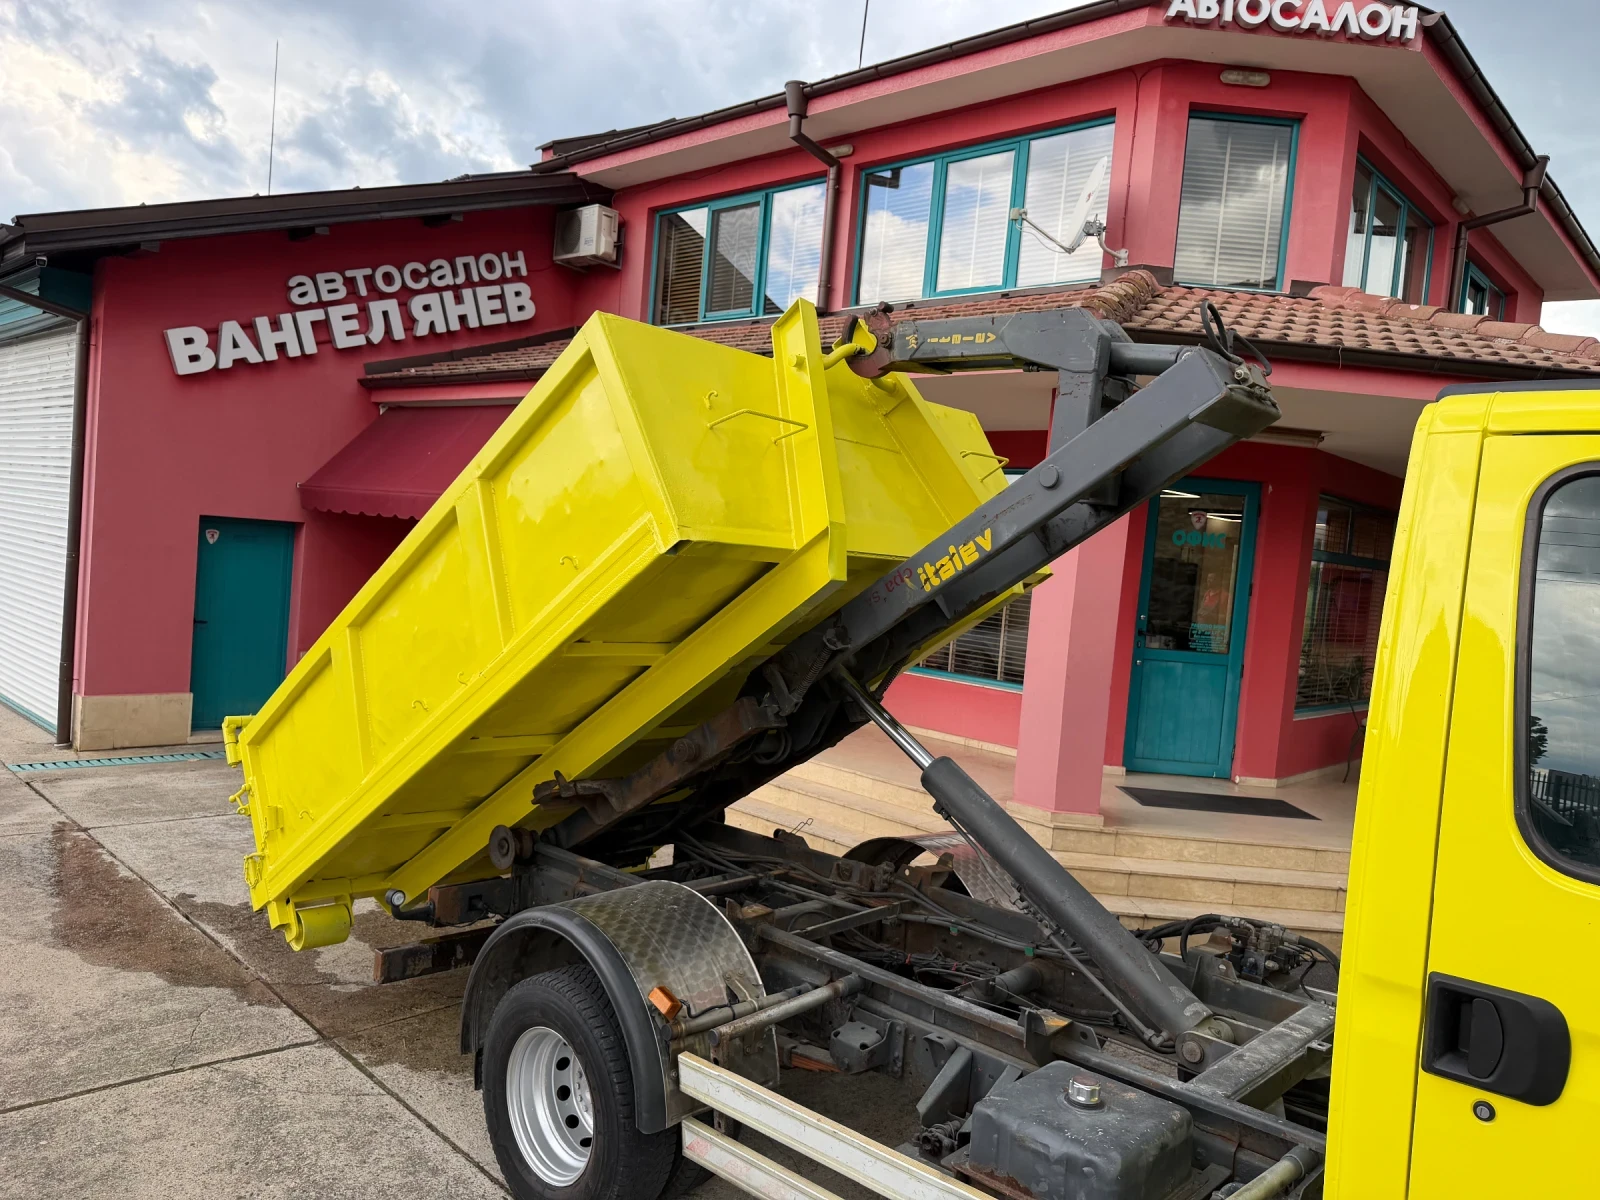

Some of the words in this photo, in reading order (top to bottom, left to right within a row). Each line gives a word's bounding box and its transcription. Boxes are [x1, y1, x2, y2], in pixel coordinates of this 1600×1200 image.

[287, 250, 528, 305] автосалон
[163, 298, 405, 376] ВАНГЕЛ
[407, 282, 536, 338] ЯНЕВ
[1171, 529, 1227, 549] ОФИС
